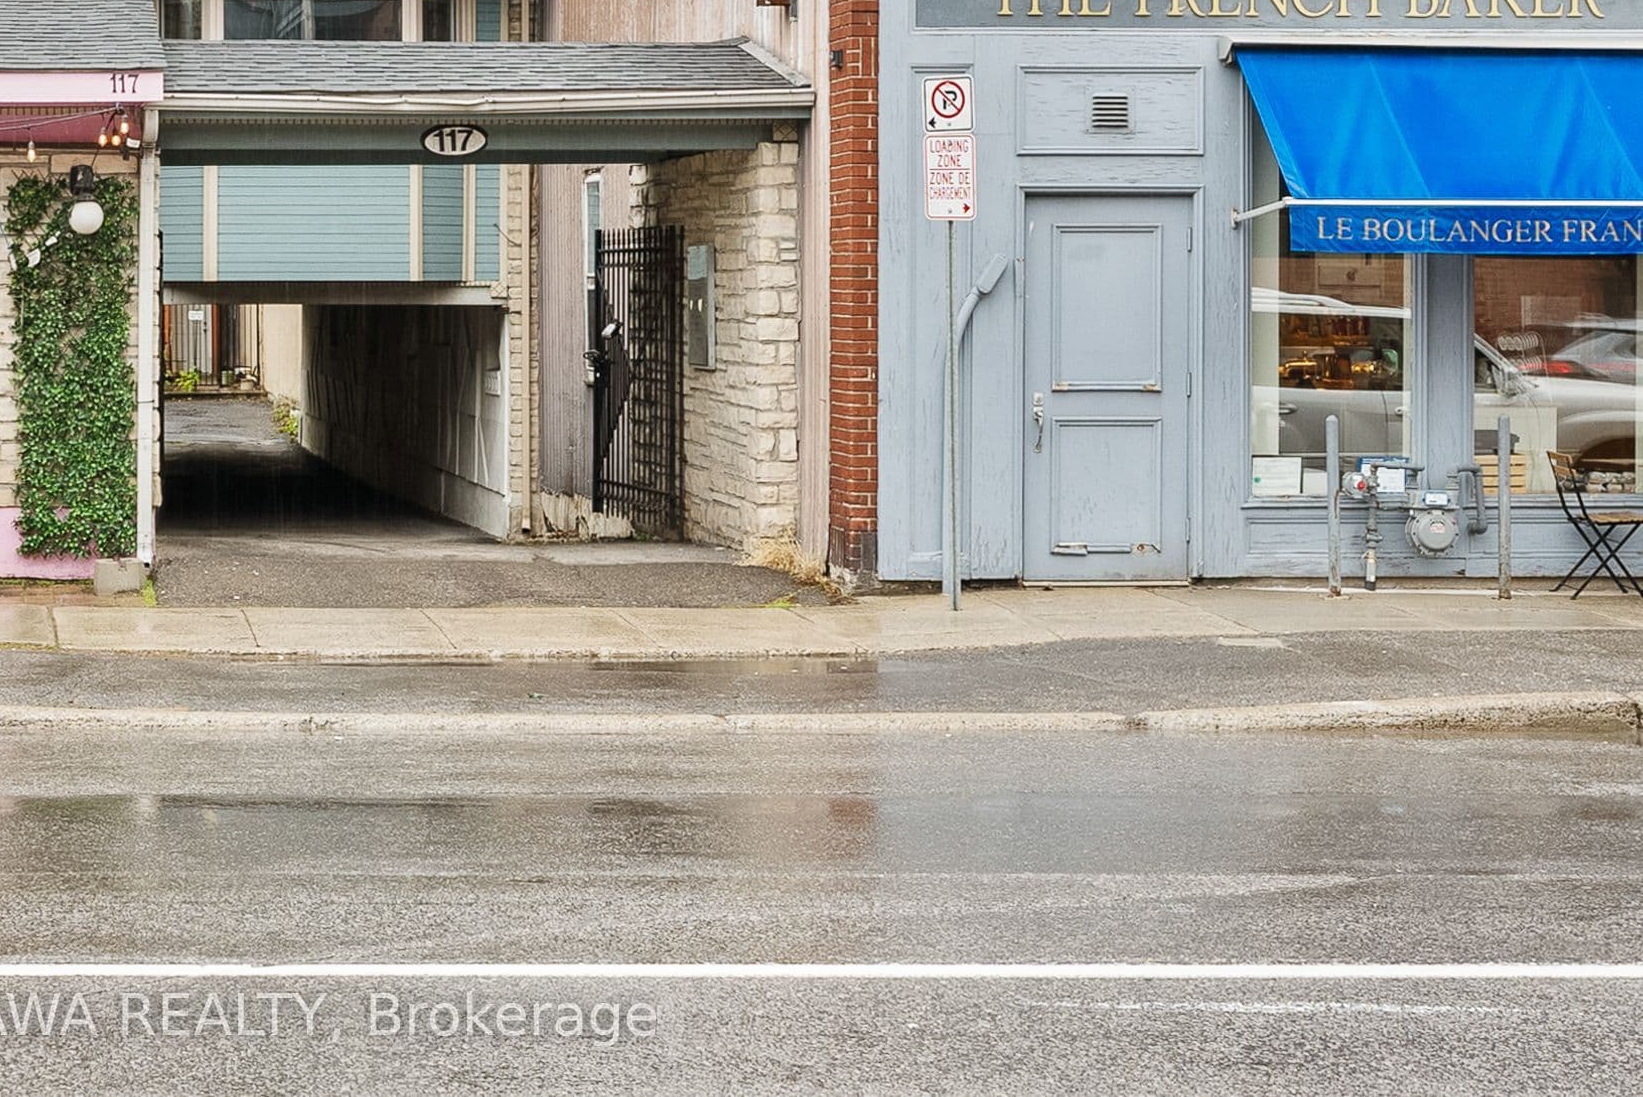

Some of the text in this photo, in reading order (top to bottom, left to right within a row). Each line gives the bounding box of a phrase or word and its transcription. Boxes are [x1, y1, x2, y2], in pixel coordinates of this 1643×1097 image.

[110, 73, 139, 93] 117
[433, 130, 473, 151] 117
[930, 140, 969, 153] LOADING
[937, 155, 962, 167] ZONE
[929, 172, 970, 185] ZONE DE
[1317, 216, 1353, 240] LE
[1362, 218, 1552, 243] BOULANGER
